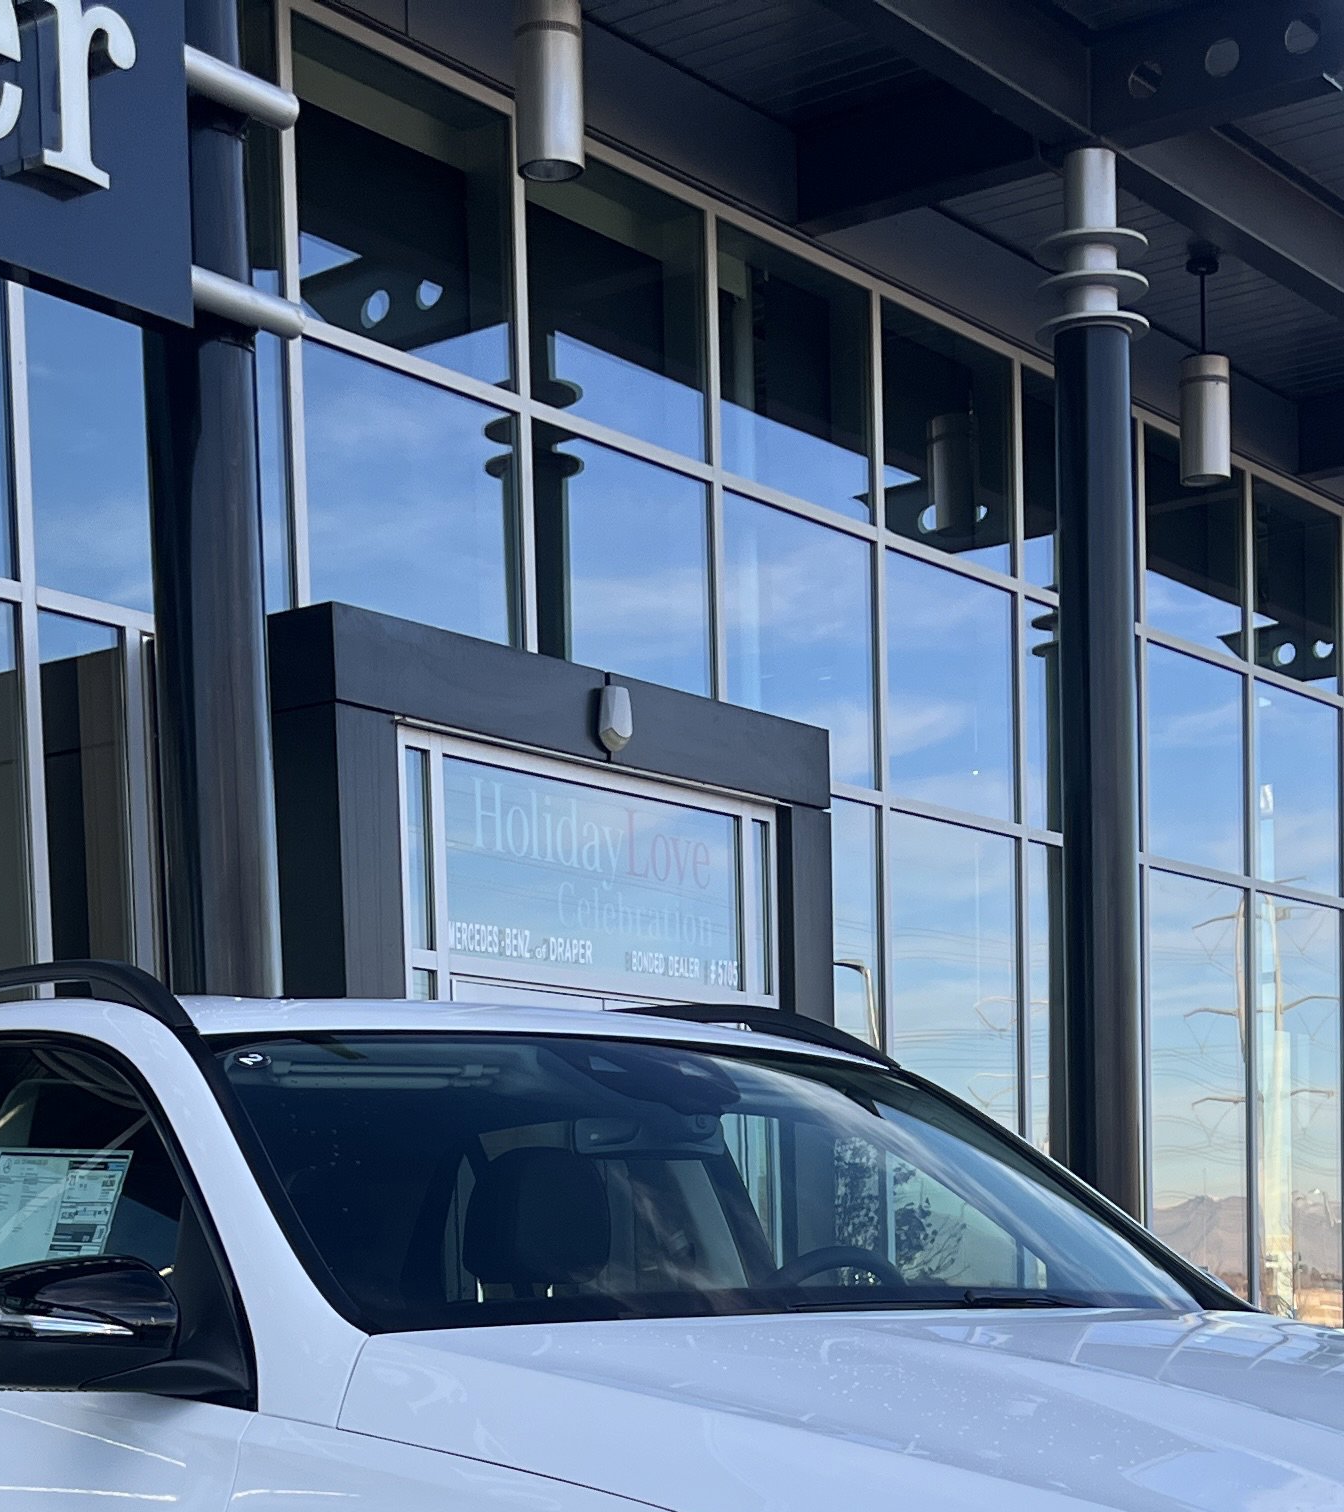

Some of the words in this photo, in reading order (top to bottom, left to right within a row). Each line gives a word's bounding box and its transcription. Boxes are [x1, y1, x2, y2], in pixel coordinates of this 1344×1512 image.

[471, 777, 625, 891] Holiday
[624, 808, 711, 891] Love
[557, 880, 712, 948] Celebration
[535, 944, 546, 959] of
[549, 936, 593, 964] DRAPER
[631, 950, 665, 975] BONDED
[668, 955, 701, 979] DEALER
